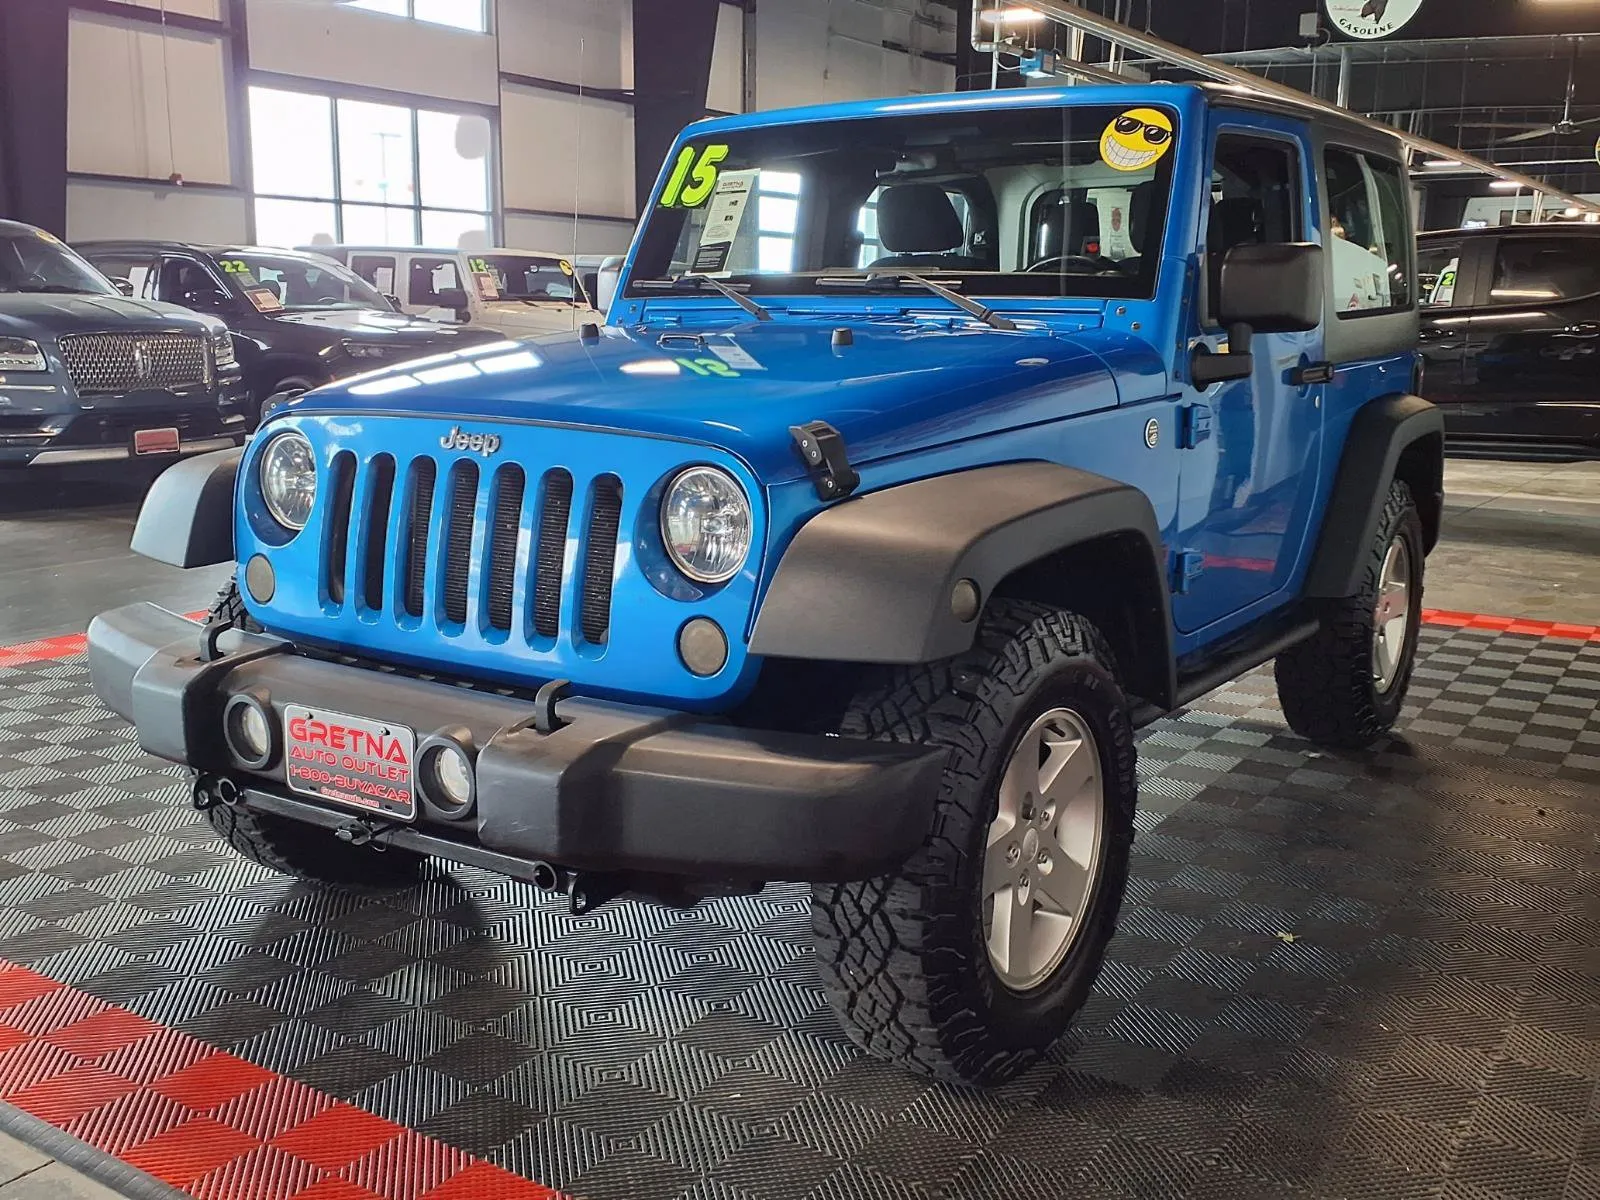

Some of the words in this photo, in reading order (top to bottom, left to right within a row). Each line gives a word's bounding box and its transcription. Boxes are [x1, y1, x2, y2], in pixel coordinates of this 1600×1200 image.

[1339, 18, 1394, 35] GASOLINE
[660, 144, 729, 207] 15
[219, 260, 250, 273] 22
[440, 425, 500, 457] Jeep
[289, 716, 408, 765] GRETNA
[290, 744, 337, 766] AUTO
[341, 755, 409, 783] OUTLET
[290, 764, 411, 804] 1-800-BUYACAR
